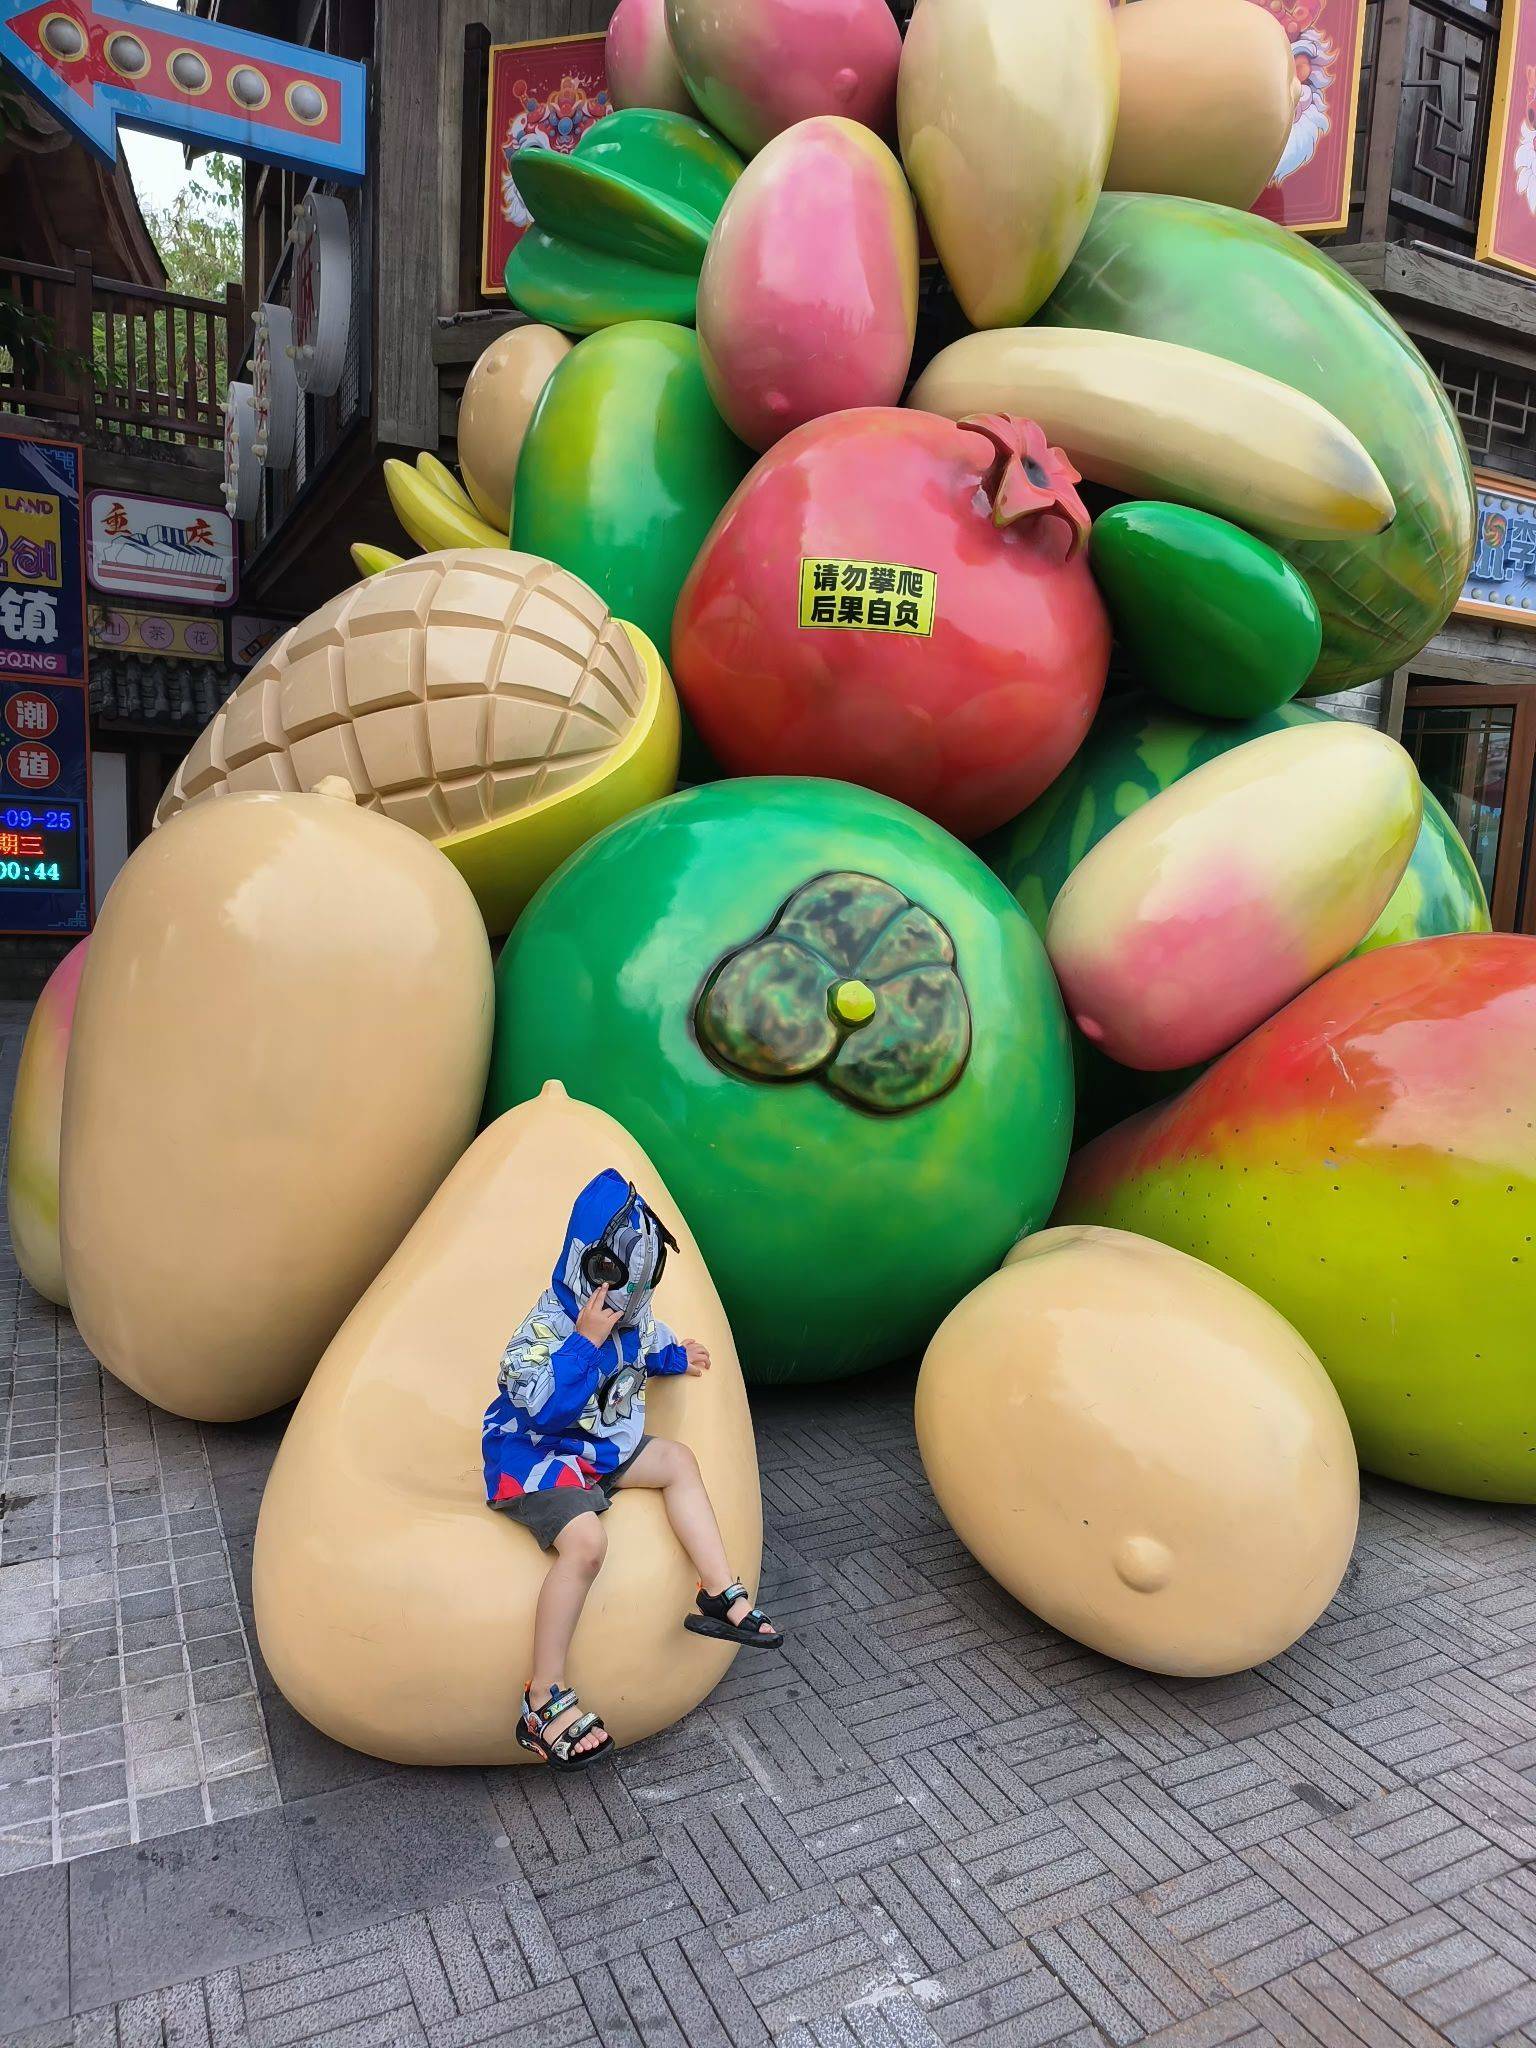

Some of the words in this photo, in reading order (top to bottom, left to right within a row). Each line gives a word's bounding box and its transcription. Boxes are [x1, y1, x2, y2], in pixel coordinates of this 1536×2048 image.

[4, 494, 54, 515] LAND
[813, 563, 924, 598] 请勿攀爬
[0, 586, 58, 644] 镇
[810, 595, 920, 629] 后果自负
[16, 700, 48, 730] 潮
[18, 751, 49, 779] 道
